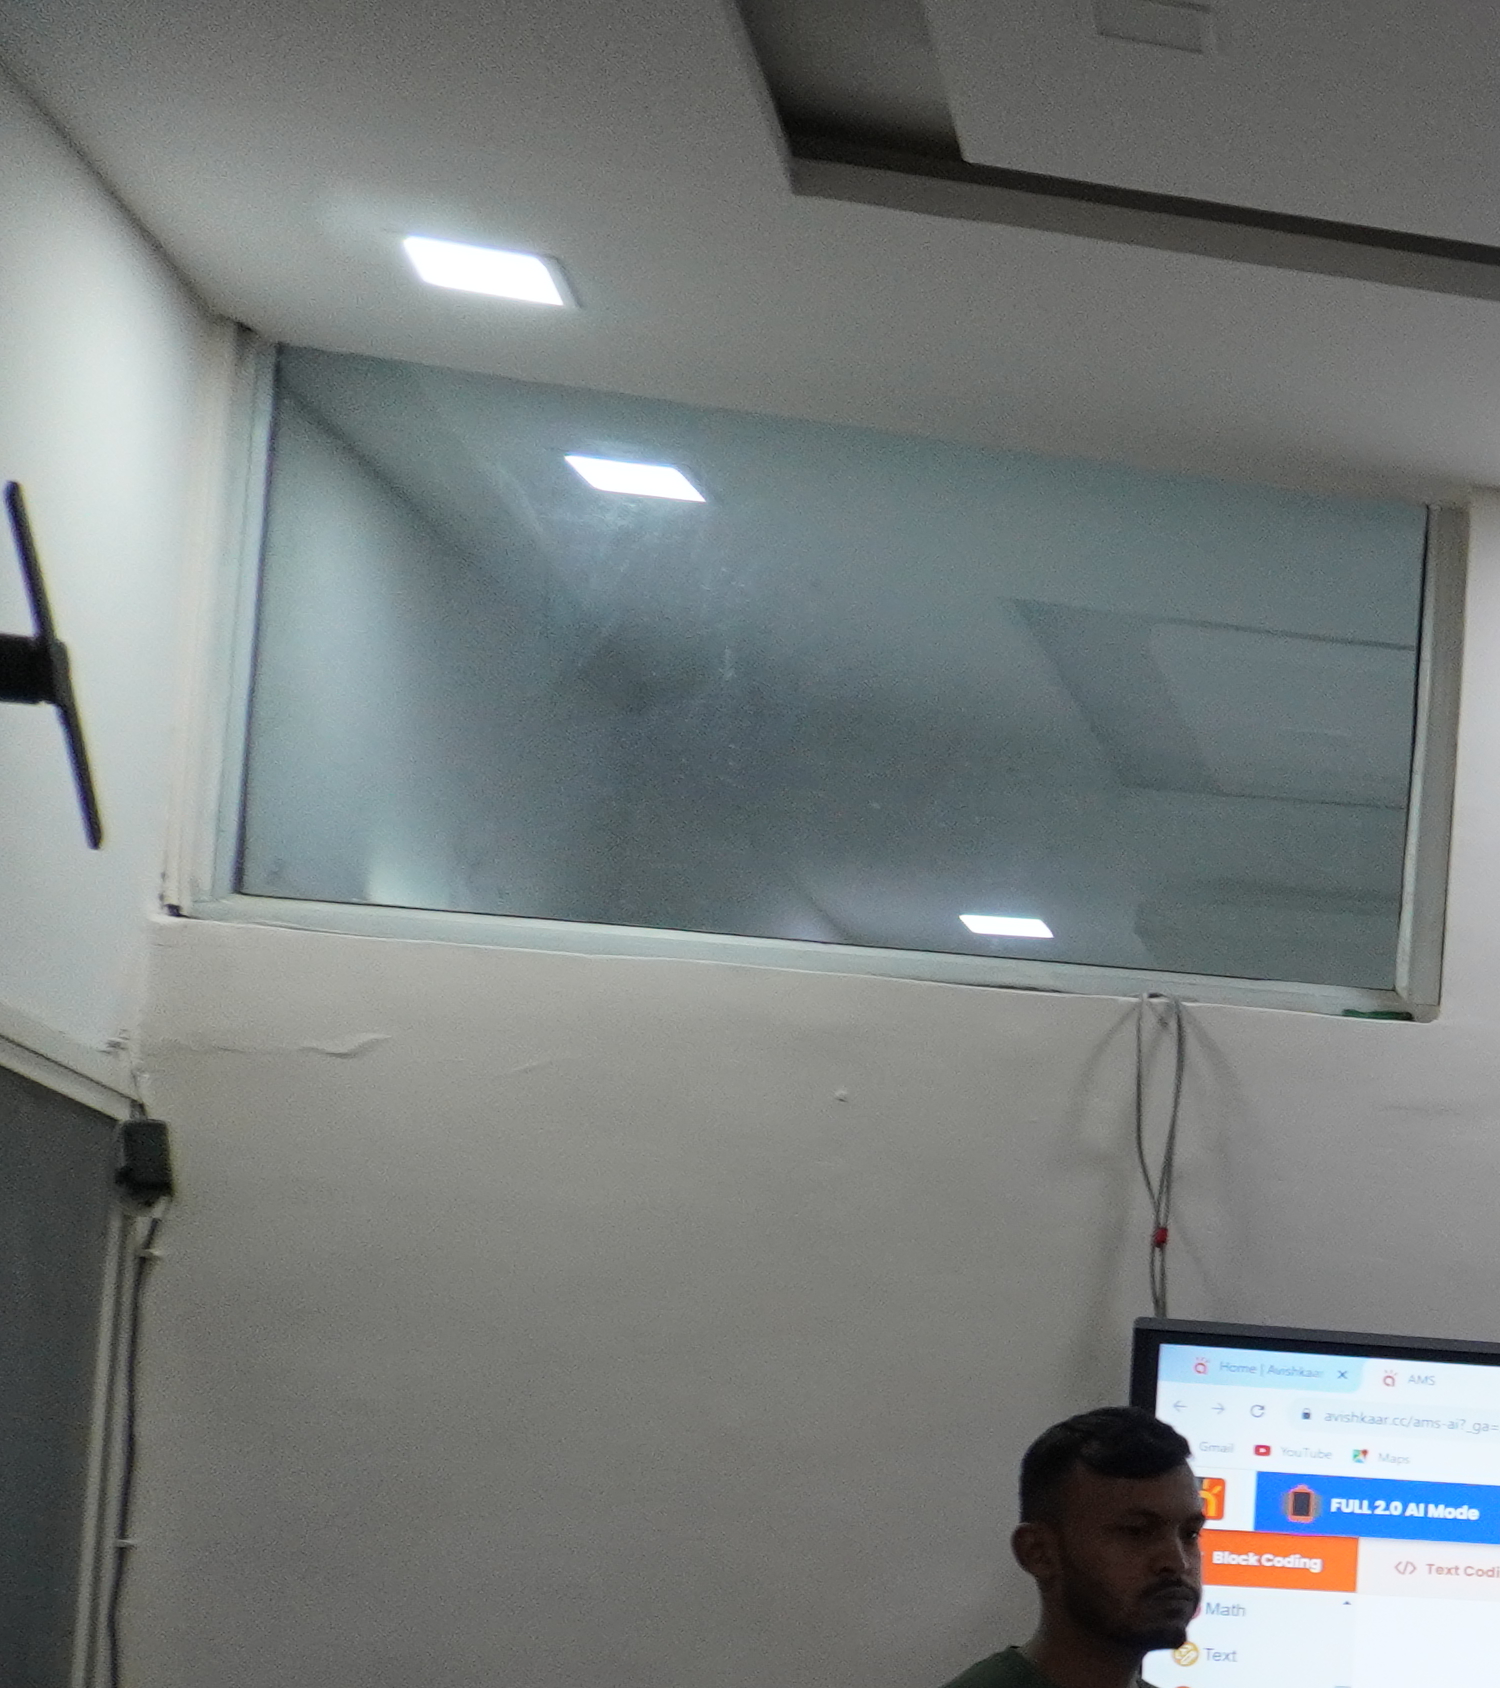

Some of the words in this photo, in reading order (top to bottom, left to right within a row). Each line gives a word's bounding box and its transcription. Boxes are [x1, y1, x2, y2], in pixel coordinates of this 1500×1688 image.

[1219, 1361, 1257, 1374] Home
[1407, 1374, 1435, 1386] AMS
[1198, 1440, 1234, 1454] Gmail
[1280, 1445, 1332, 1460] YouTube
[1377, 1451, 1410, 1466] Maps
[1330, 1497, 1371, 1513] FULL
[1373, 1500, 1403, 1515] 2.0
[1404, 1502, 1424, 1516] AI
[1427, 1503, 1479, 1520] Mode
[1211, 1549, 1258, 1567] Block
[1259, 1552, 1323, 1572] Coding
[1425, 1562, 1460, 1577] Text
[1205, 1602, 1247, 1617] Math
[1203, 1648, 1238, 1662] Text
